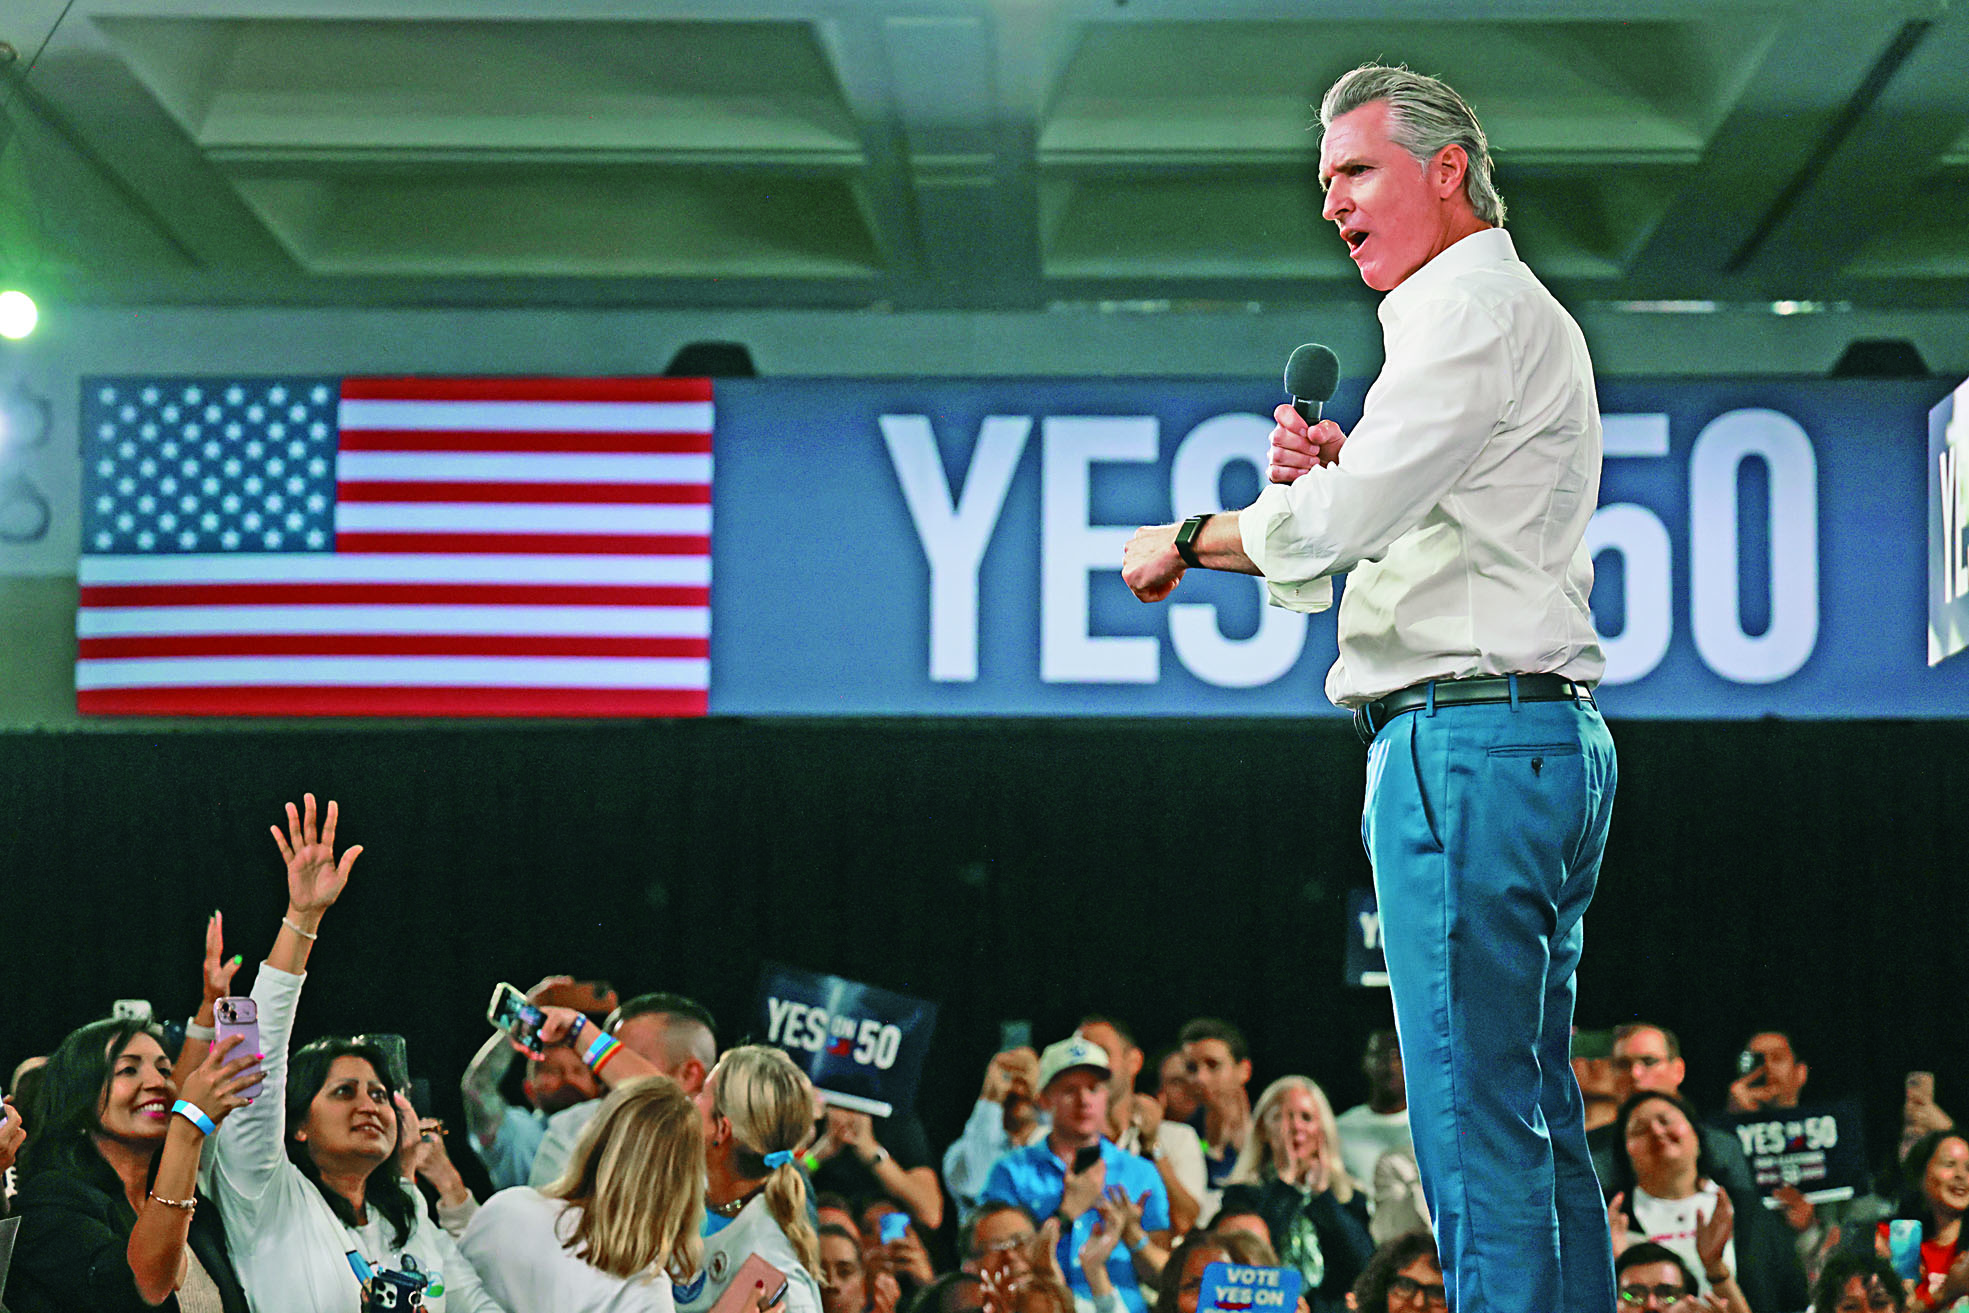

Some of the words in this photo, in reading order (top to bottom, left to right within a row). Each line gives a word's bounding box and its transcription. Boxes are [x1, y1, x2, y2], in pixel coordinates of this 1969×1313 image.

[879, 412, 1308, 688] YES
[1587, 408, 1819, 685] 50
[1939, 445, 1969, 604] YE
[768, 996, 828, 1052] YES
[854, 1019, 902, 1069] 50
[1736, 1120, 1786, 1156] YES
[1804, 1115, 1838, 1150] 50
[1215, 1286, 1252, 1304] YES
[1254, 1288, 1285, 1307] ON
[1227, 1267, 1280, 1287] VOTE
